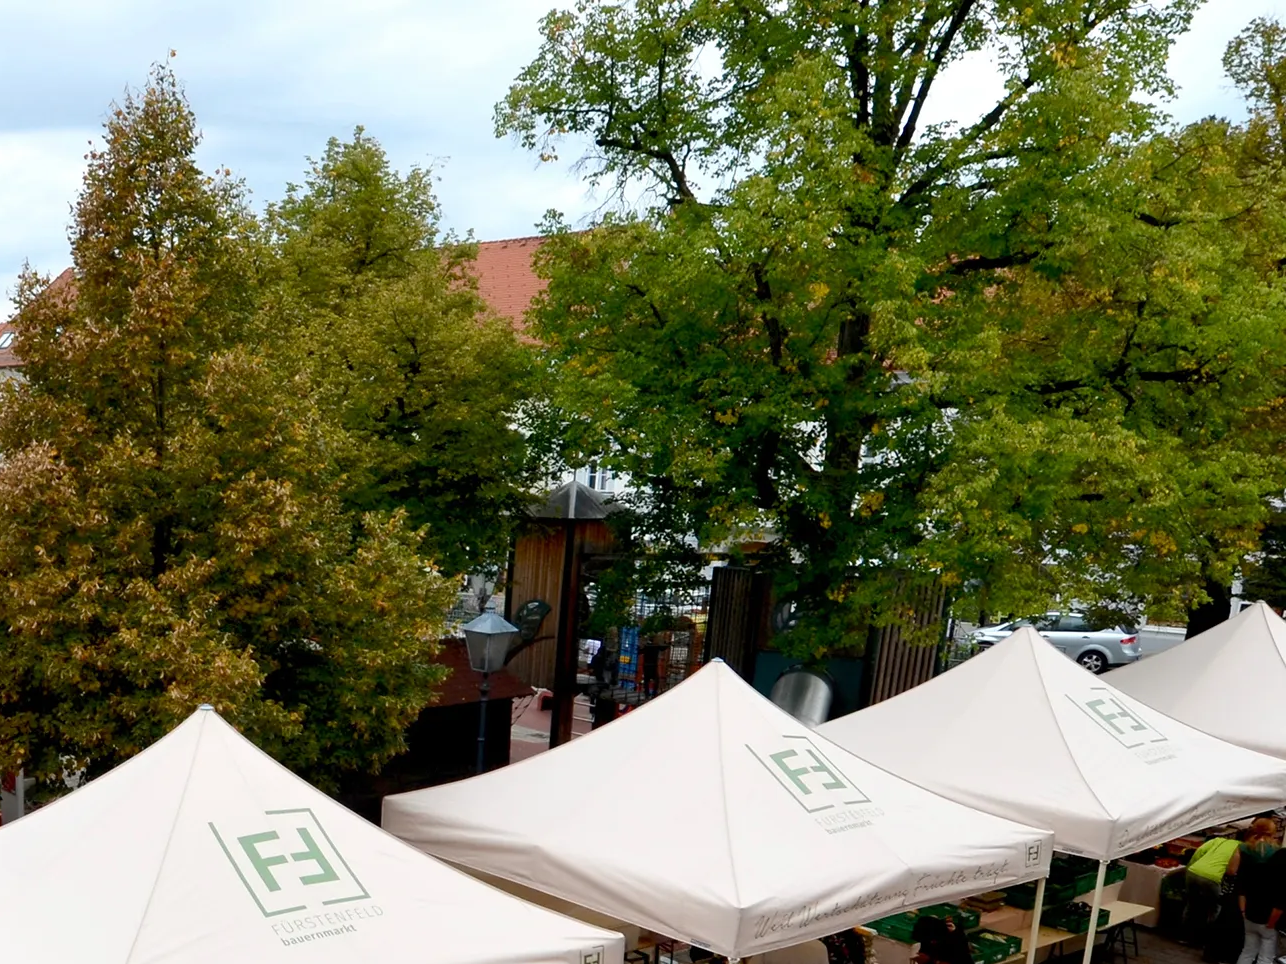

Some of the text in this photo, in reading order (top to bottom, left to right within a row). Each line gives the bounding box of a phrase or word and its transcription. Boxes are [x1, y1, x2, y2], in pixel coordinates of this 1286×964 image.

[271, 905, 384, 935] FÜRSTENFELD
[280, 924, 357, 946] bauernmarkt
[754, 910, 794, 940] Weil
